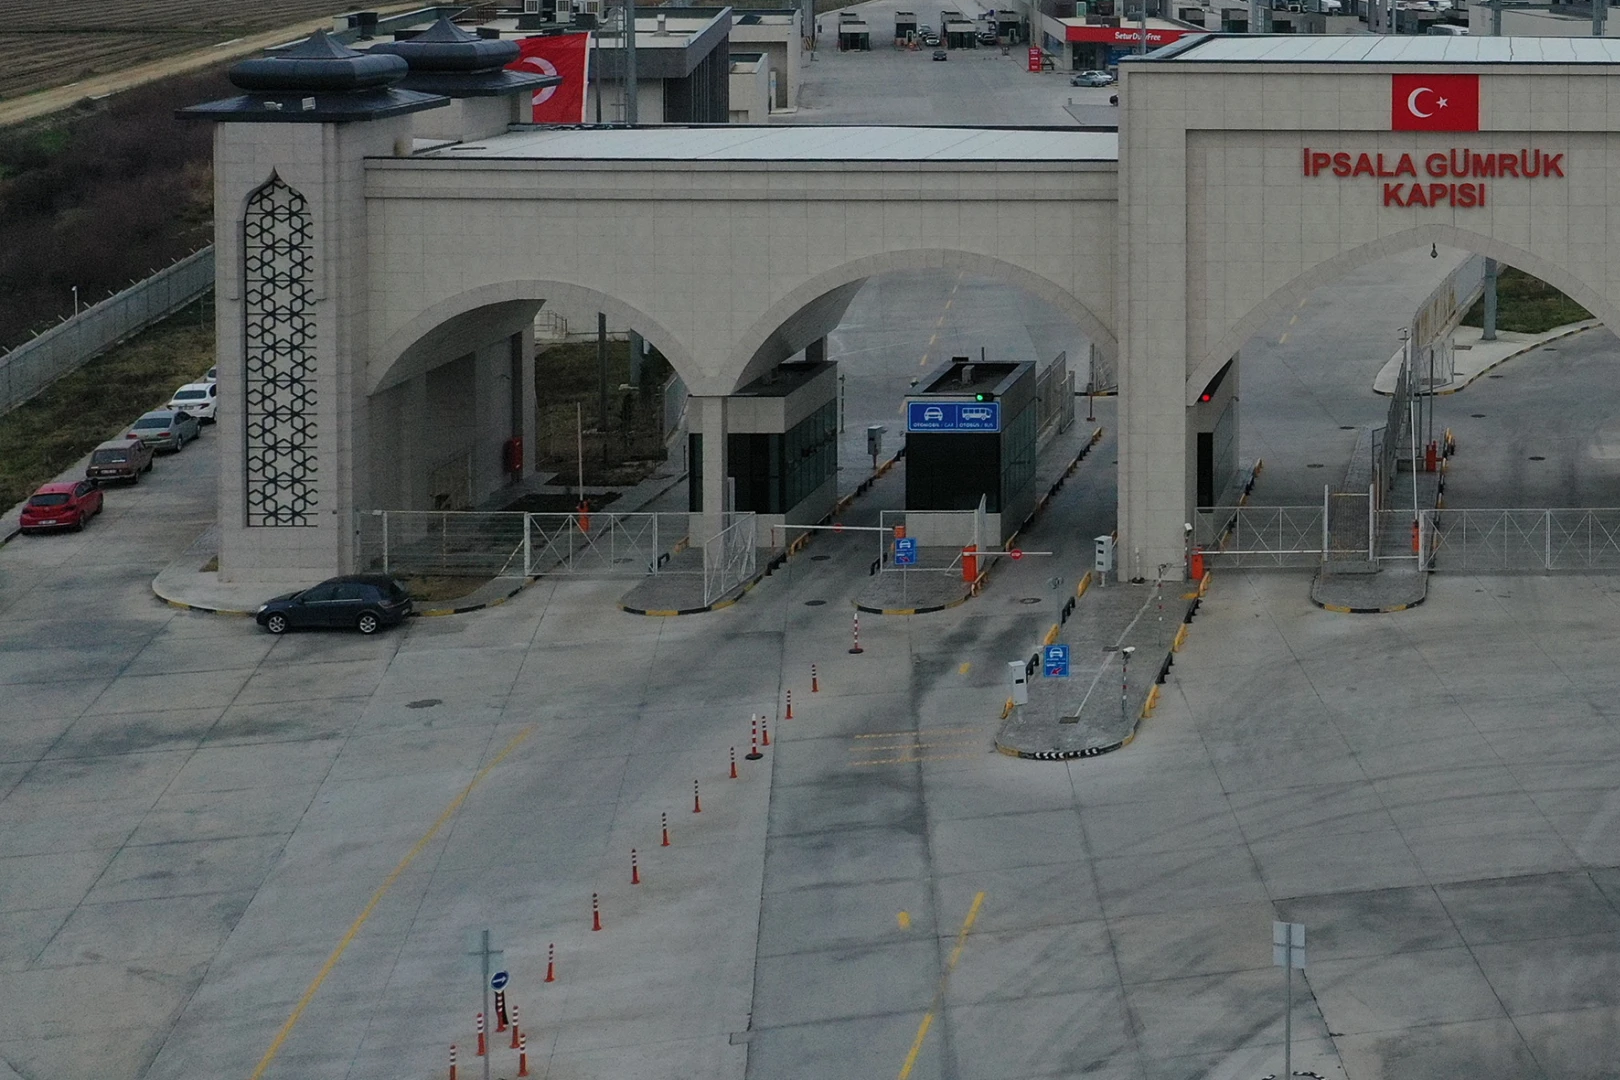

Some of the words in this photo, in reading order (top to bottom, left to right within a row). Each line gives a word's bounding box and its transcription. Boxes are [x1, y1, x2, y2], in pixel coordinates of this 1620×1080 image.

[1303, 147, 1417, 178] İPSALA
[1425, 148, 1565, 178] GÜMRÜK
[1383, 183, 1486, 208] KAPISI
